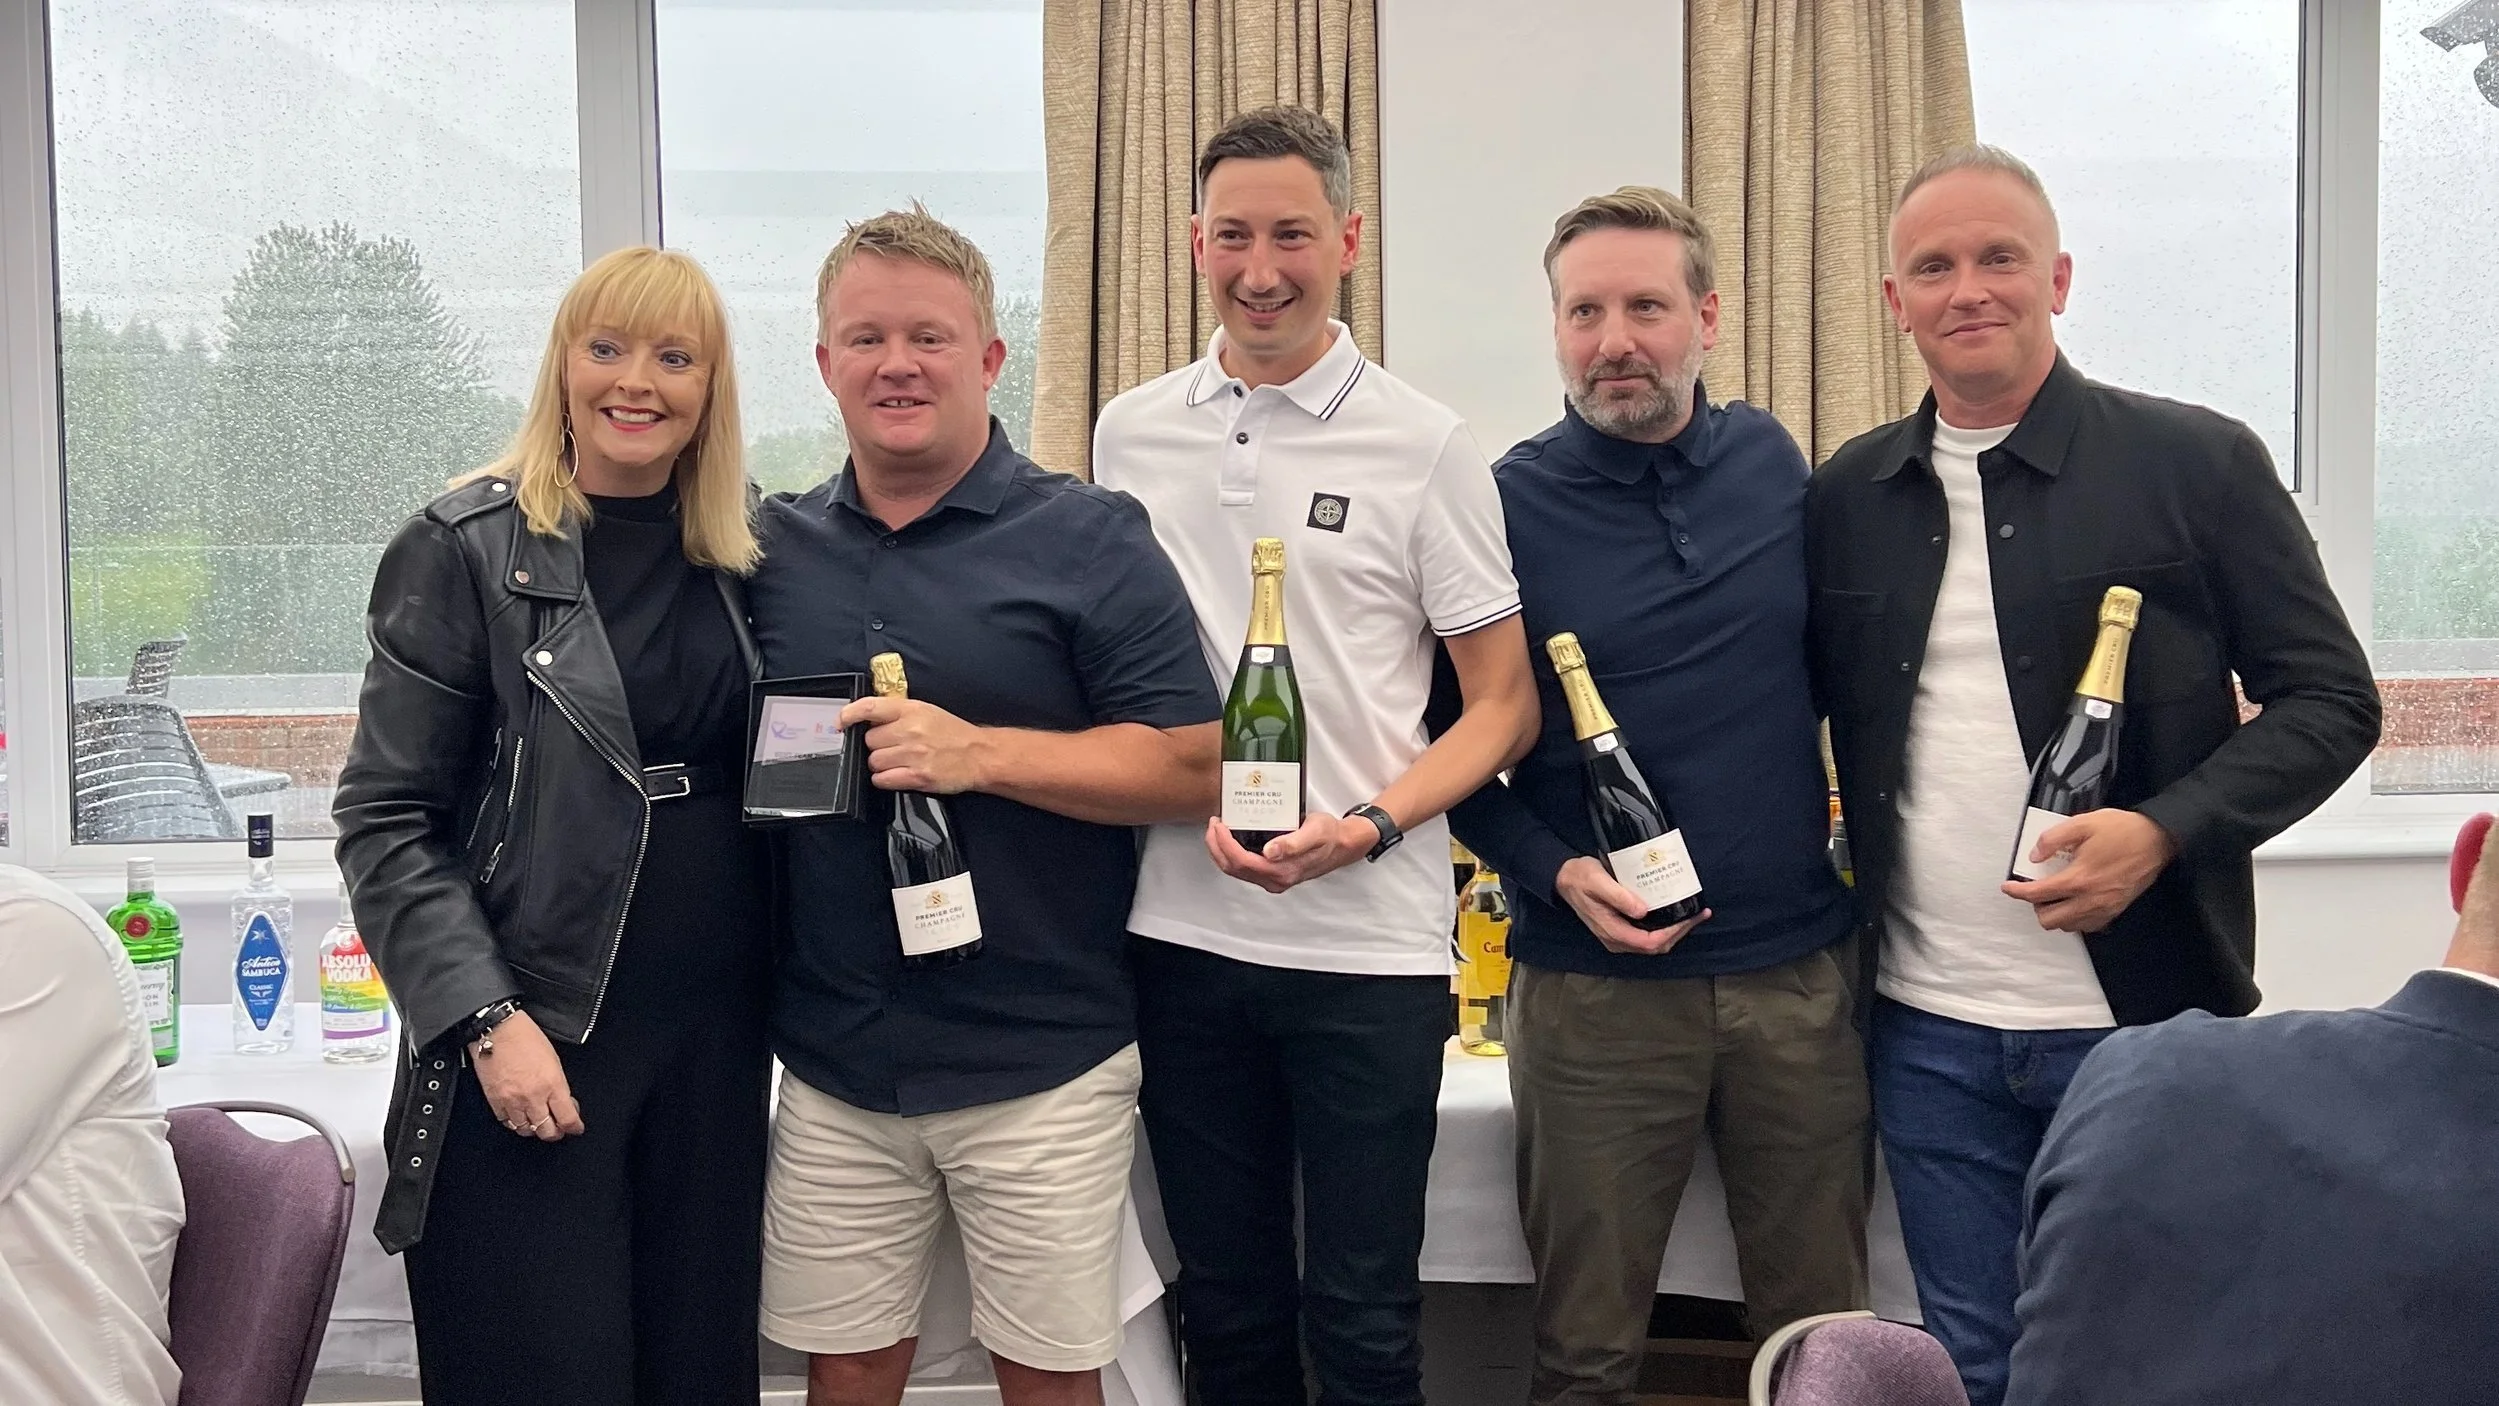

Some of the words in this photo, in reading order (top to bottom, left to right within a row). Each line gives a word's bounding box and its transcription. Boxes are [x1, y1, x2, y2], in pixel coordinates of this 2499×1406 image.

[1232, 798, 1284, 806] CHAMPAGNE
[1636, 865, 1667, 880] PREMIER
[1667, 860, 1680, 869] CRU
[1636, 867, 1684, 888] CHAMPAGNE
[914, 912, 966, 929] CHAMPAGNE
[915, 909, 948, 921] PREMIER
[949, 904, 963, 914] CRU
[321, 953, 372, 969] ABSOLU
[241, 967, 281, 977] SAMBUCA
[327, 966, 374, 983] VODKA
